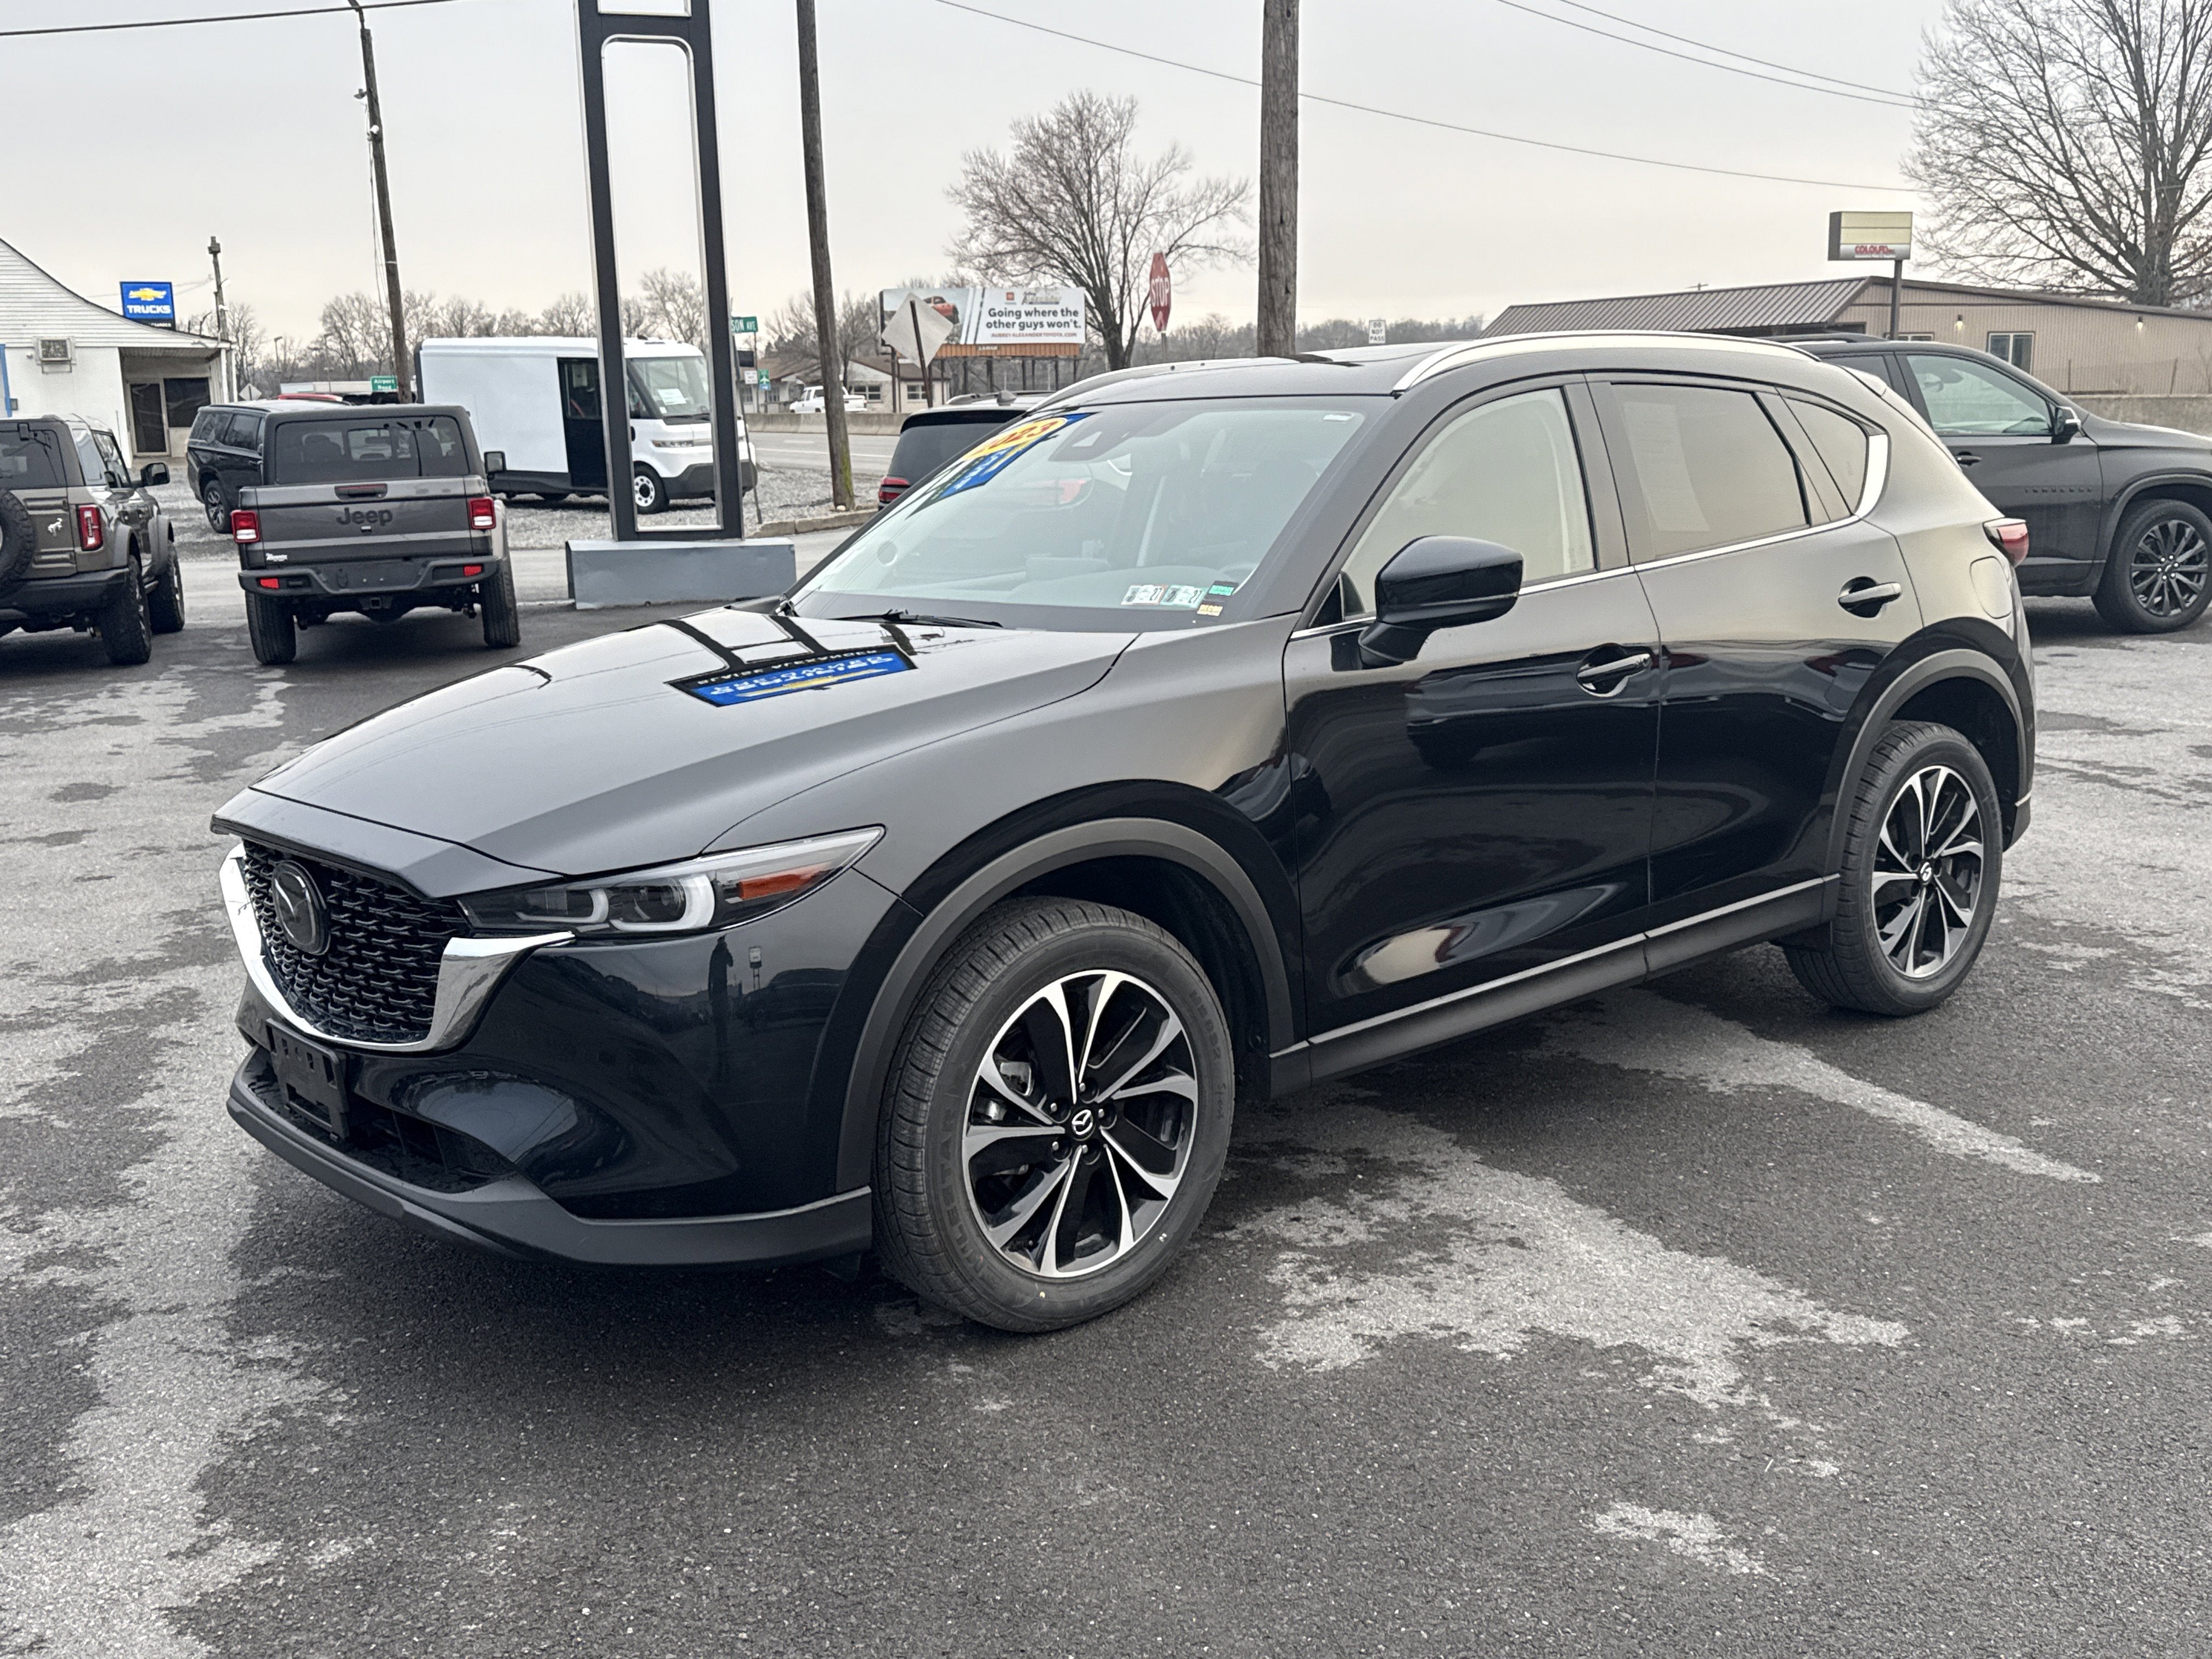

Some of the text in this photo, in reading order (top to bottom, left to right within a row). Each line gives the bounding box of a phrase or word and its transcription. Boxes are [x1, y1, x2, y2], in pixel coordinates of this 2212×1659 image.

[1151, 276, 1169, 307] STOP
[127, 304, 171, 314] TRUCKS
[988, 307, 1079, 319] Going where the
[731, 319, 744, 331] SON
[986, 319, 1081, 331] other guys won't.
[336, 507, 393, 527] Jeep
